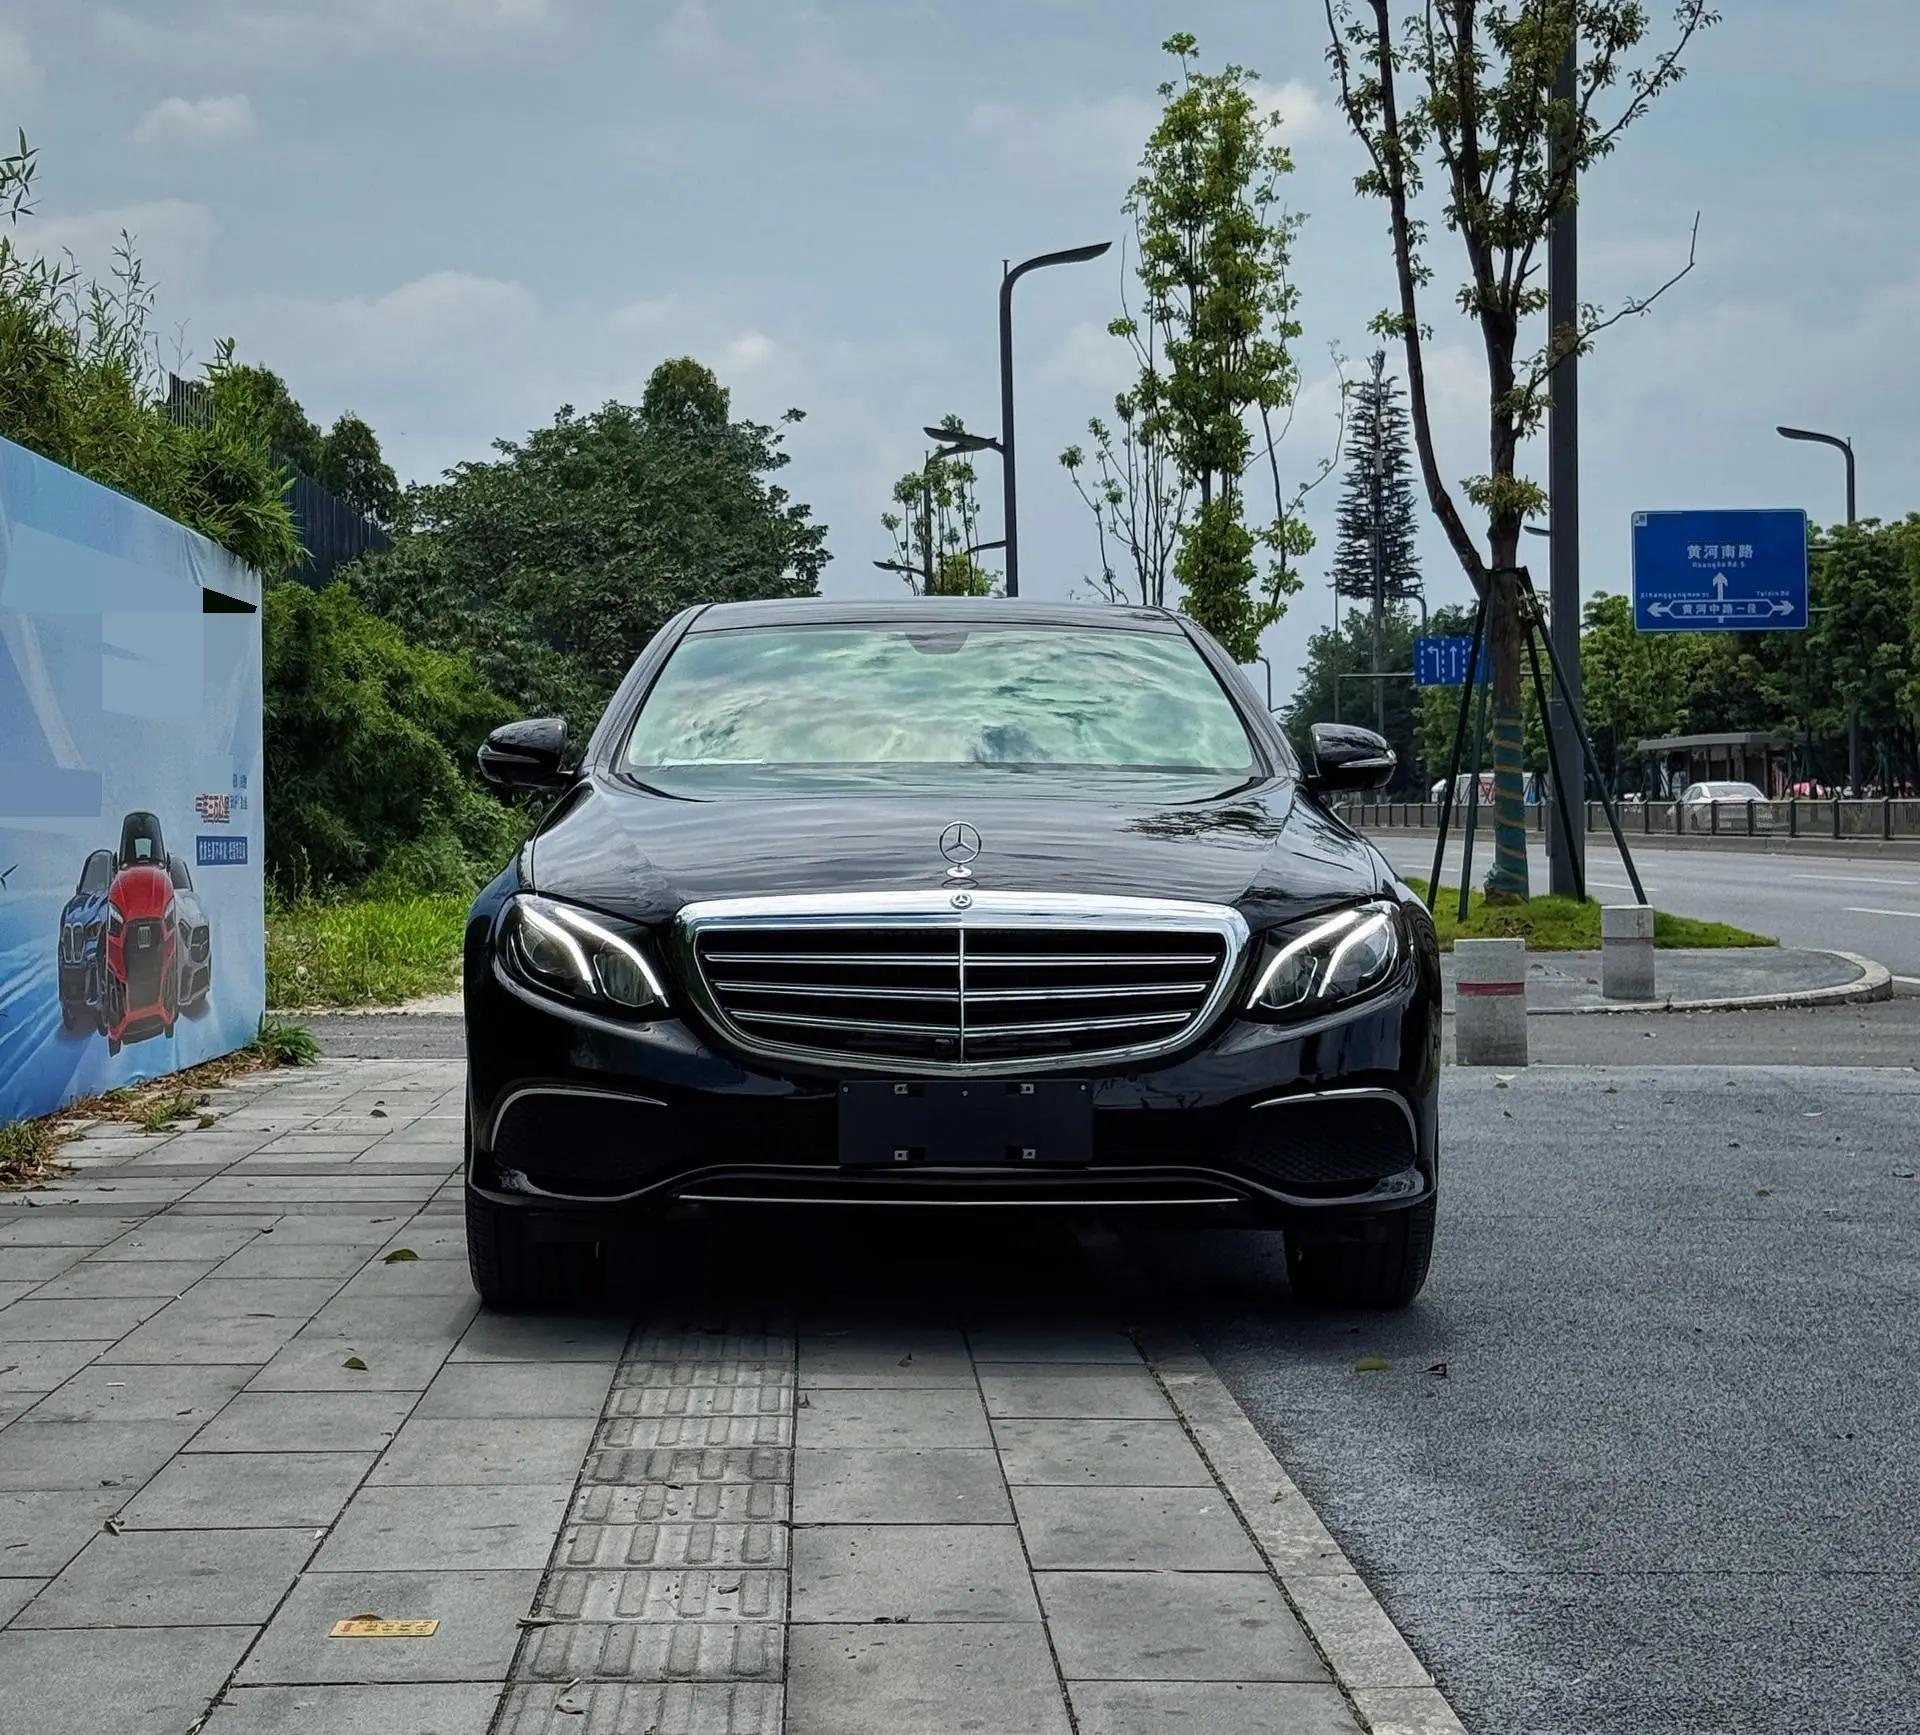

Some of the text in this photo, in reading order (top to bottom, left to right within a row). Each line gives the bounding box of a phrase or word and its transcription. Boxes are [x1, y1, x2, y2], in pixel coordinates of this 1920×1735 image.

[1687, 544, 1754, 559] 黄河南路
[1682, 603, 1757, 614] 黄河中路一段
